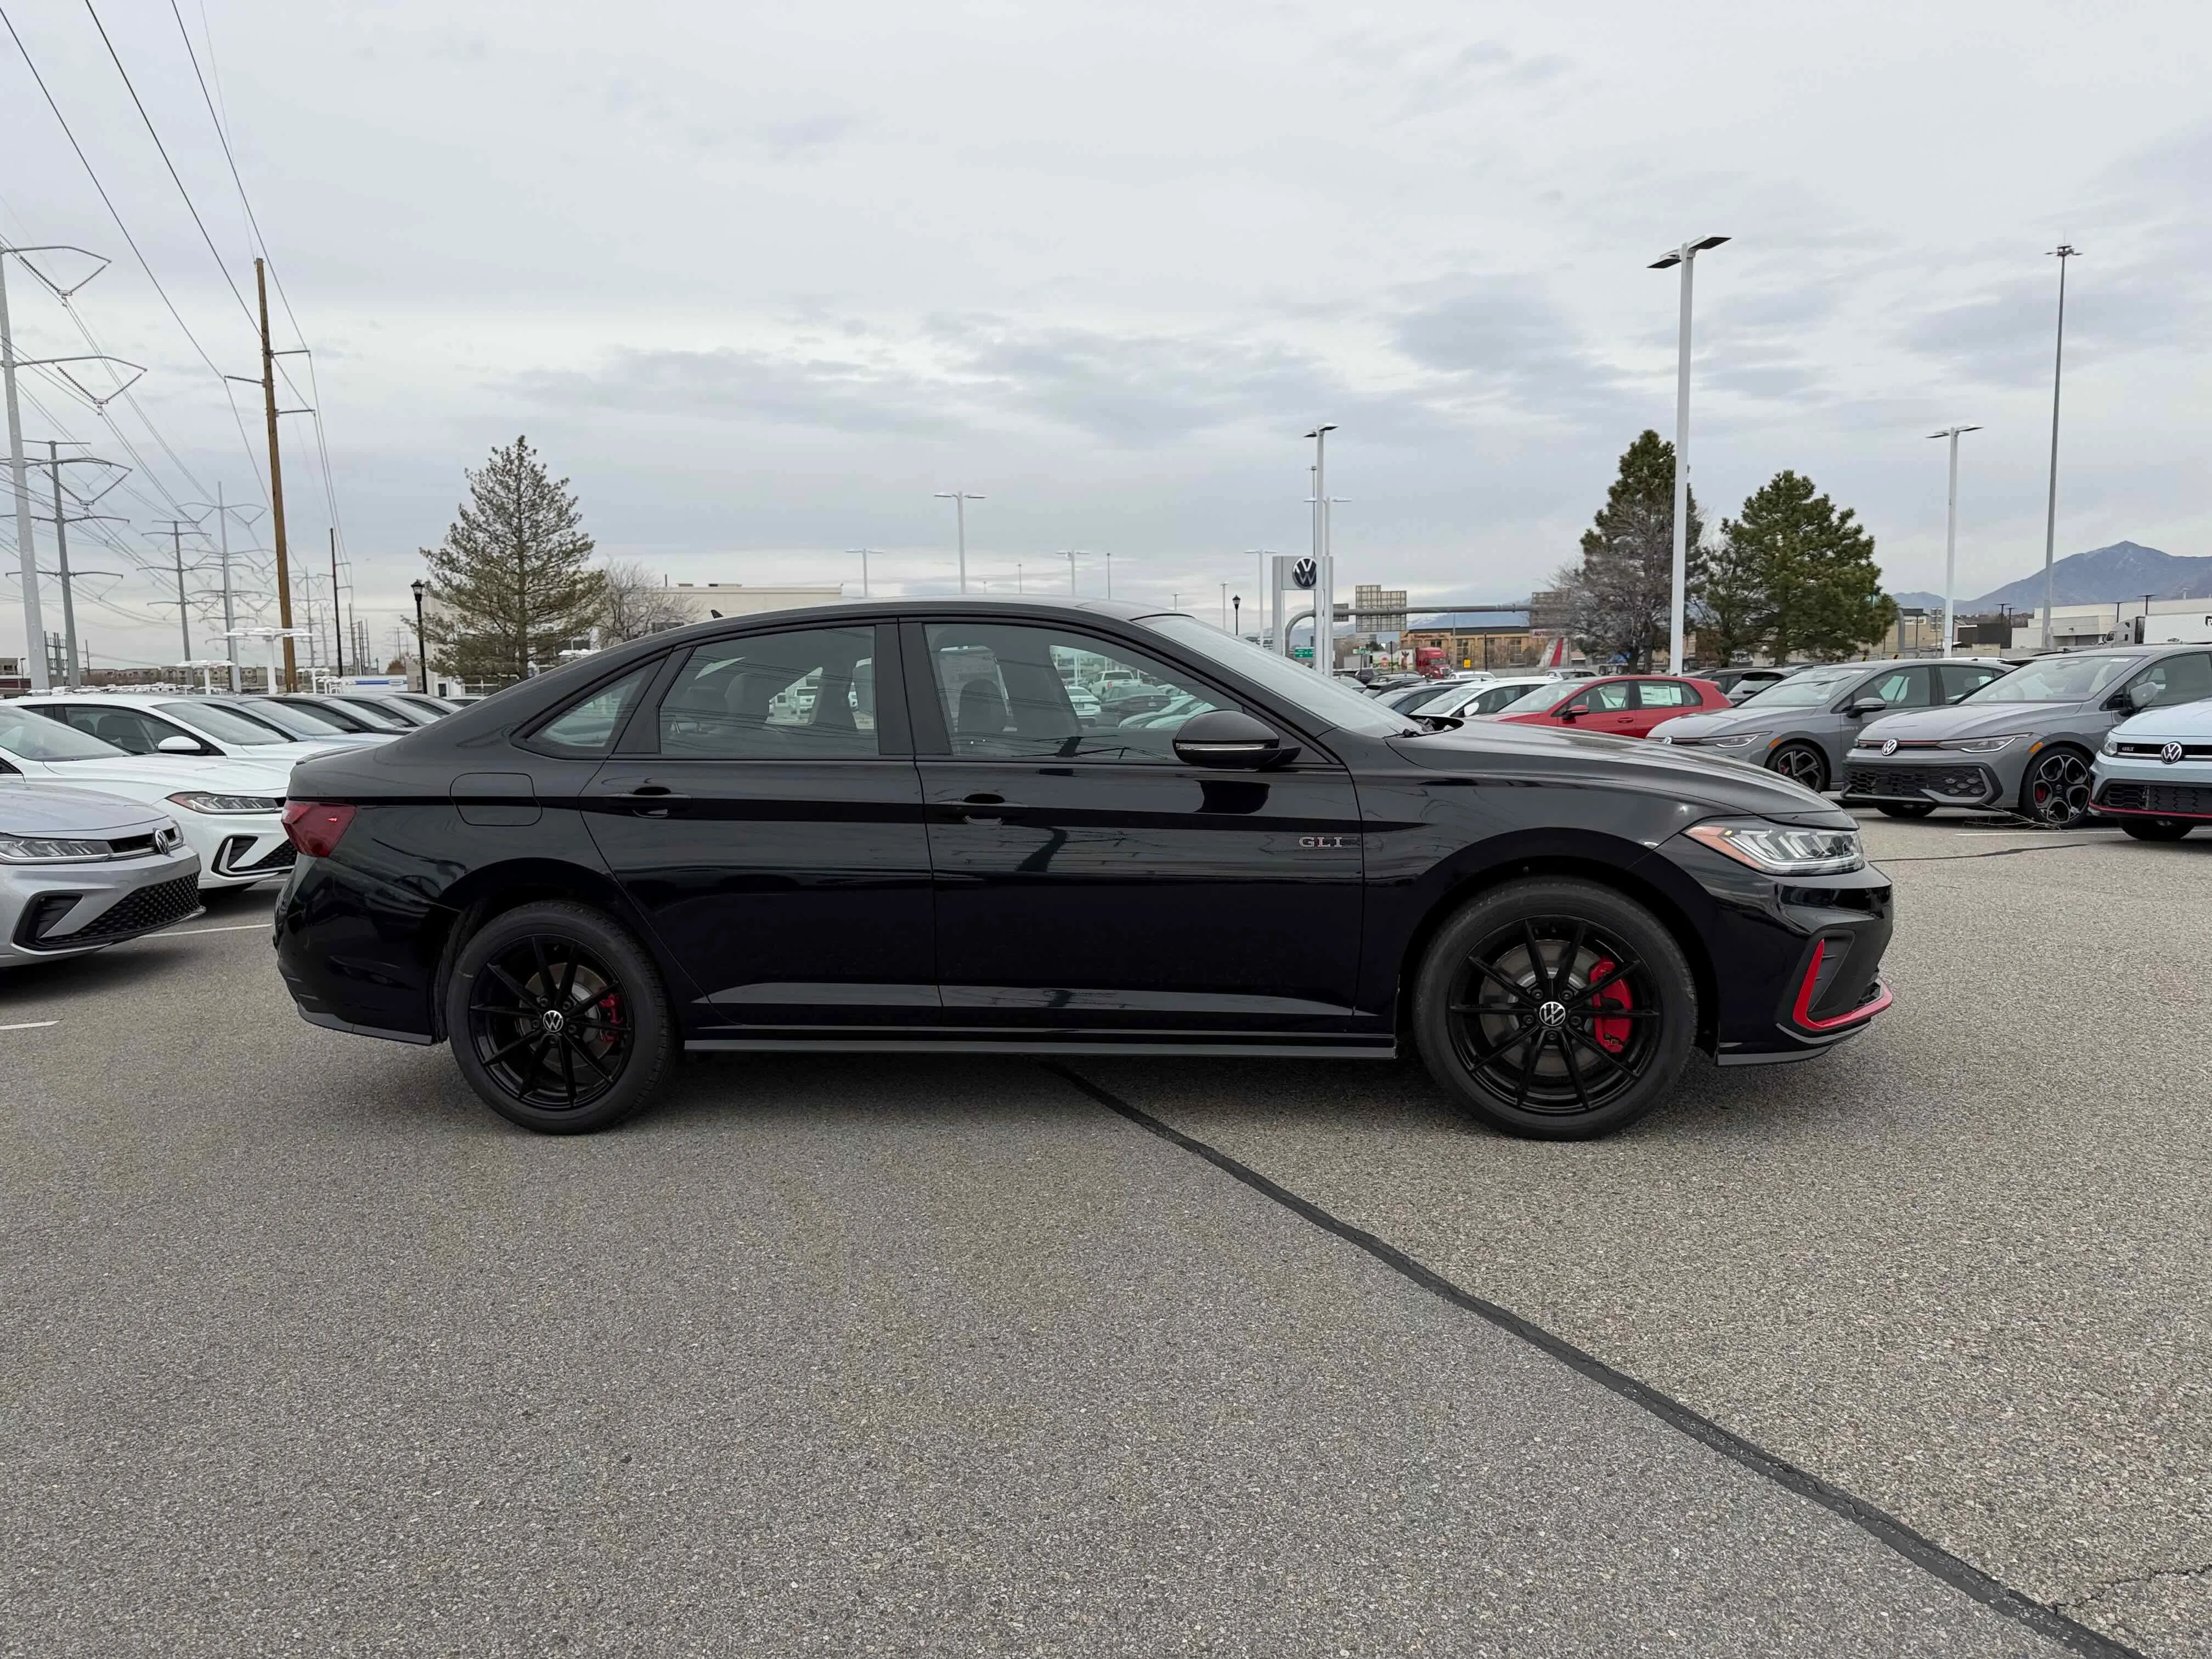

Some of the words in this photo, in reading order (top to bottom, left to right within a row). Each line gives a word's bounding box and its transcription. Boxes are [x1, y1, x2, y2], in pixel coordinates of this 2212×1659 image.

[2162, 743, 2182, 763] VW
[1299, 836, 1342, 848] GLI
[543, 1010, 563, 1032] VW
[1539, 1002, 1565, 1026] VW
